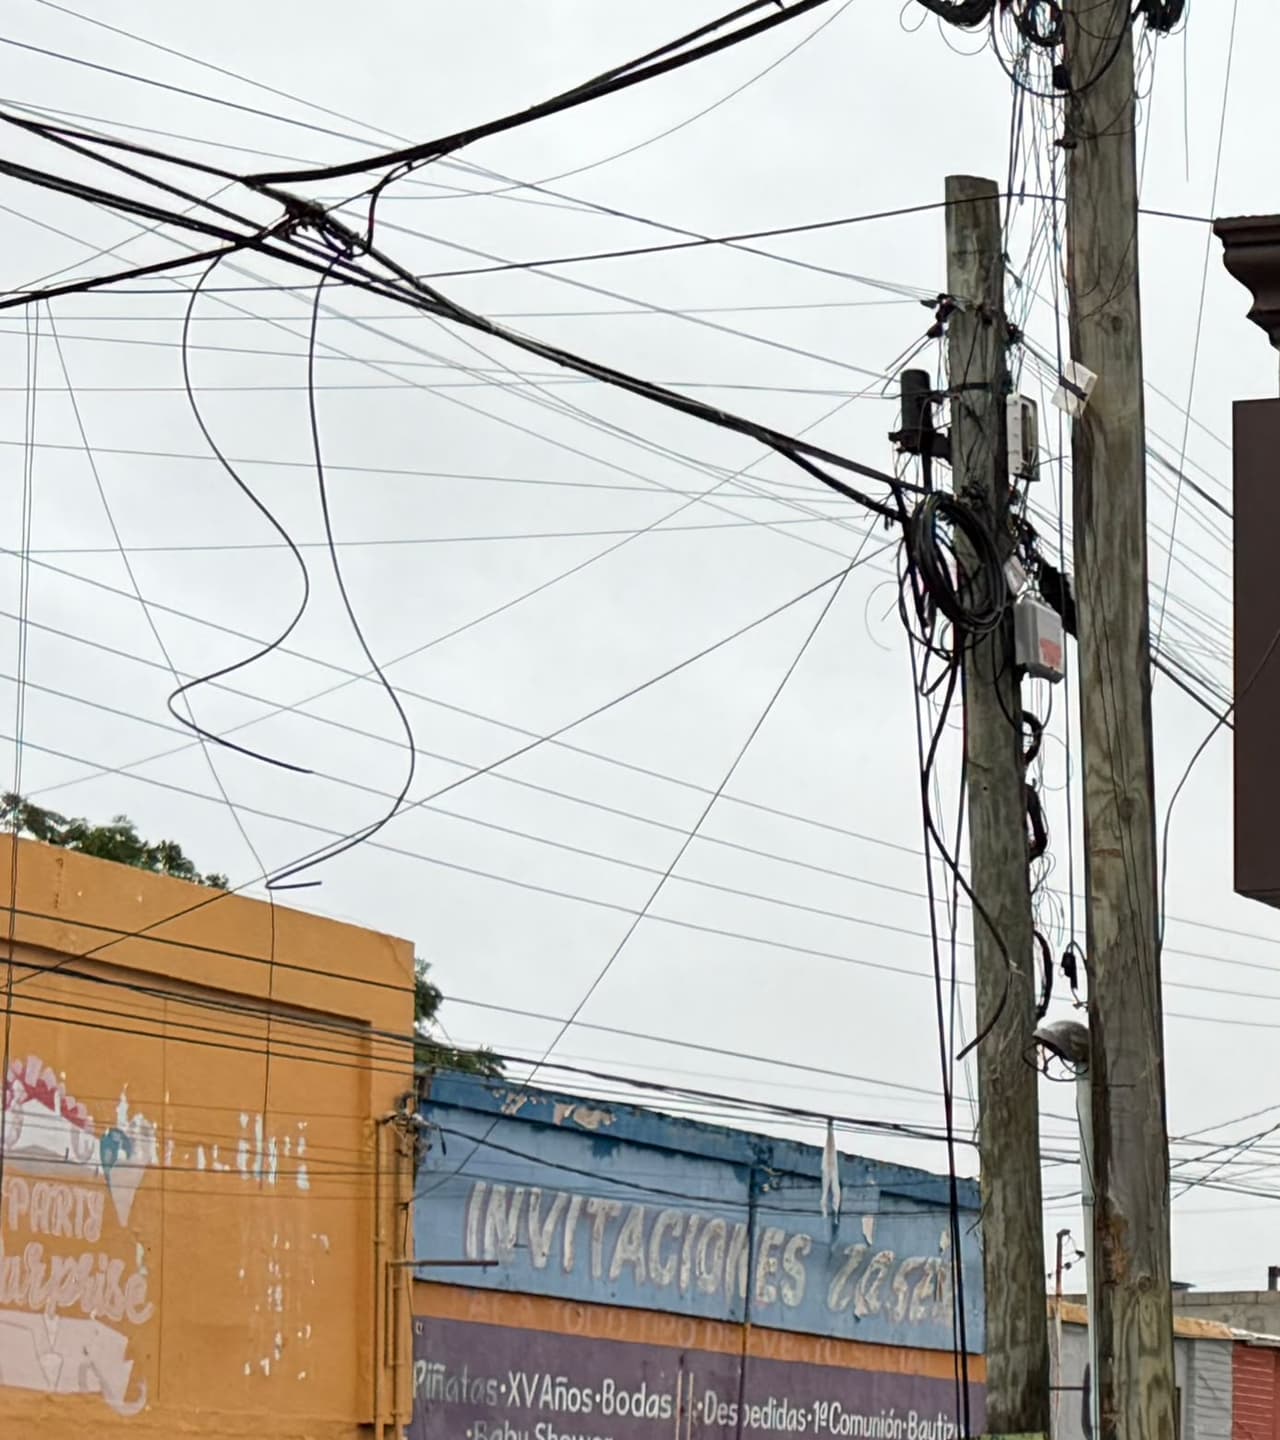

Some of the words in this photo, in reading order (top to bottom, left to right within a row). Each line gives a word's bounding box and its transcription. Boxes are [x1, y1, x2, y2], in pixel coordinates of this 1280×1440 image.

[3, 1176, 105, 1243] PARTY
[466, 1181, 812, 1308] INVITACIONES
[0, 1240, 154, 1326] urprise
[507, 1370, 539, 1408] XV
[538, 1375, 593, 1414] Años
[601, 1378, 673, 1419] Bodas
[829, 1401, 903, 1440] Comunión
